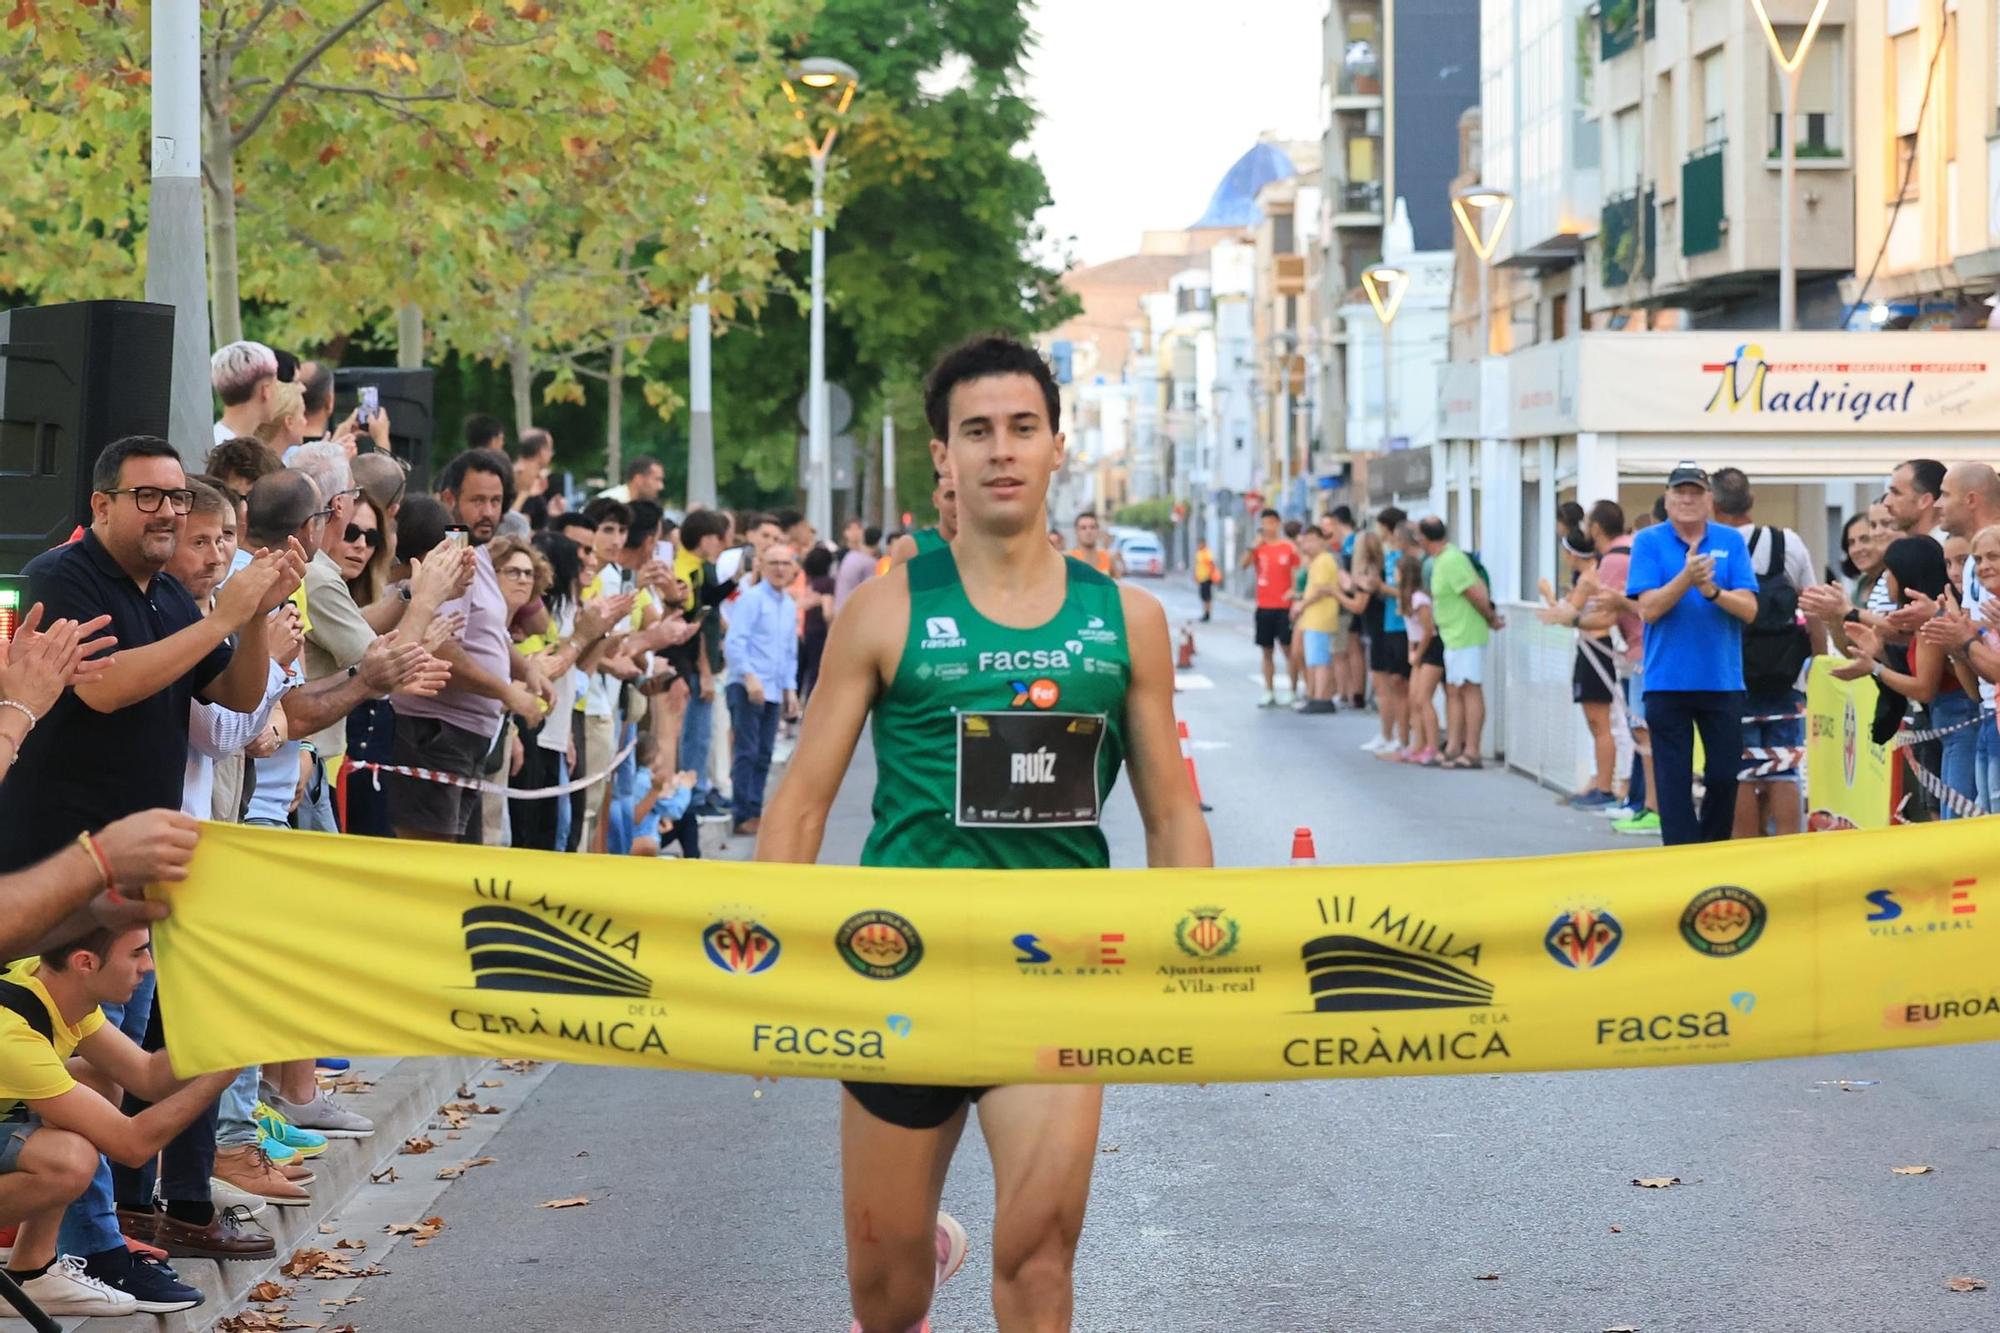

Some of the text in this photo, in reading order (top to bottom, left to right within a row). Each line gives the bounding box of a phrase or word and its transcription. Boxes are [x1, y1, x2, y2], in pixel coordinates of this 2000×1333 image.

[1705, 360, 1914, 421] Madrigal
[1011, 746, 1057, 783] RUÍZ
[474, 878, 641, 960] III MILLA
[1317, 896, 1483, 967] III MILLA
[1156, 964, 1262, 978] Ajuntament
[1179, 978, 1255, 993] Vila-real
[628, 1004, 668, 1017] DE LA
[1469, 1013, 1510, 1025] DE LA
[1905, 997, 2000, 1022] EUROA
[450, 1008, 669, 1055] CERÀMICA
[1283, 1026, 1511, 1067] CERÀMICA
[1059, 1047, 1195, 1068] EUROACE
